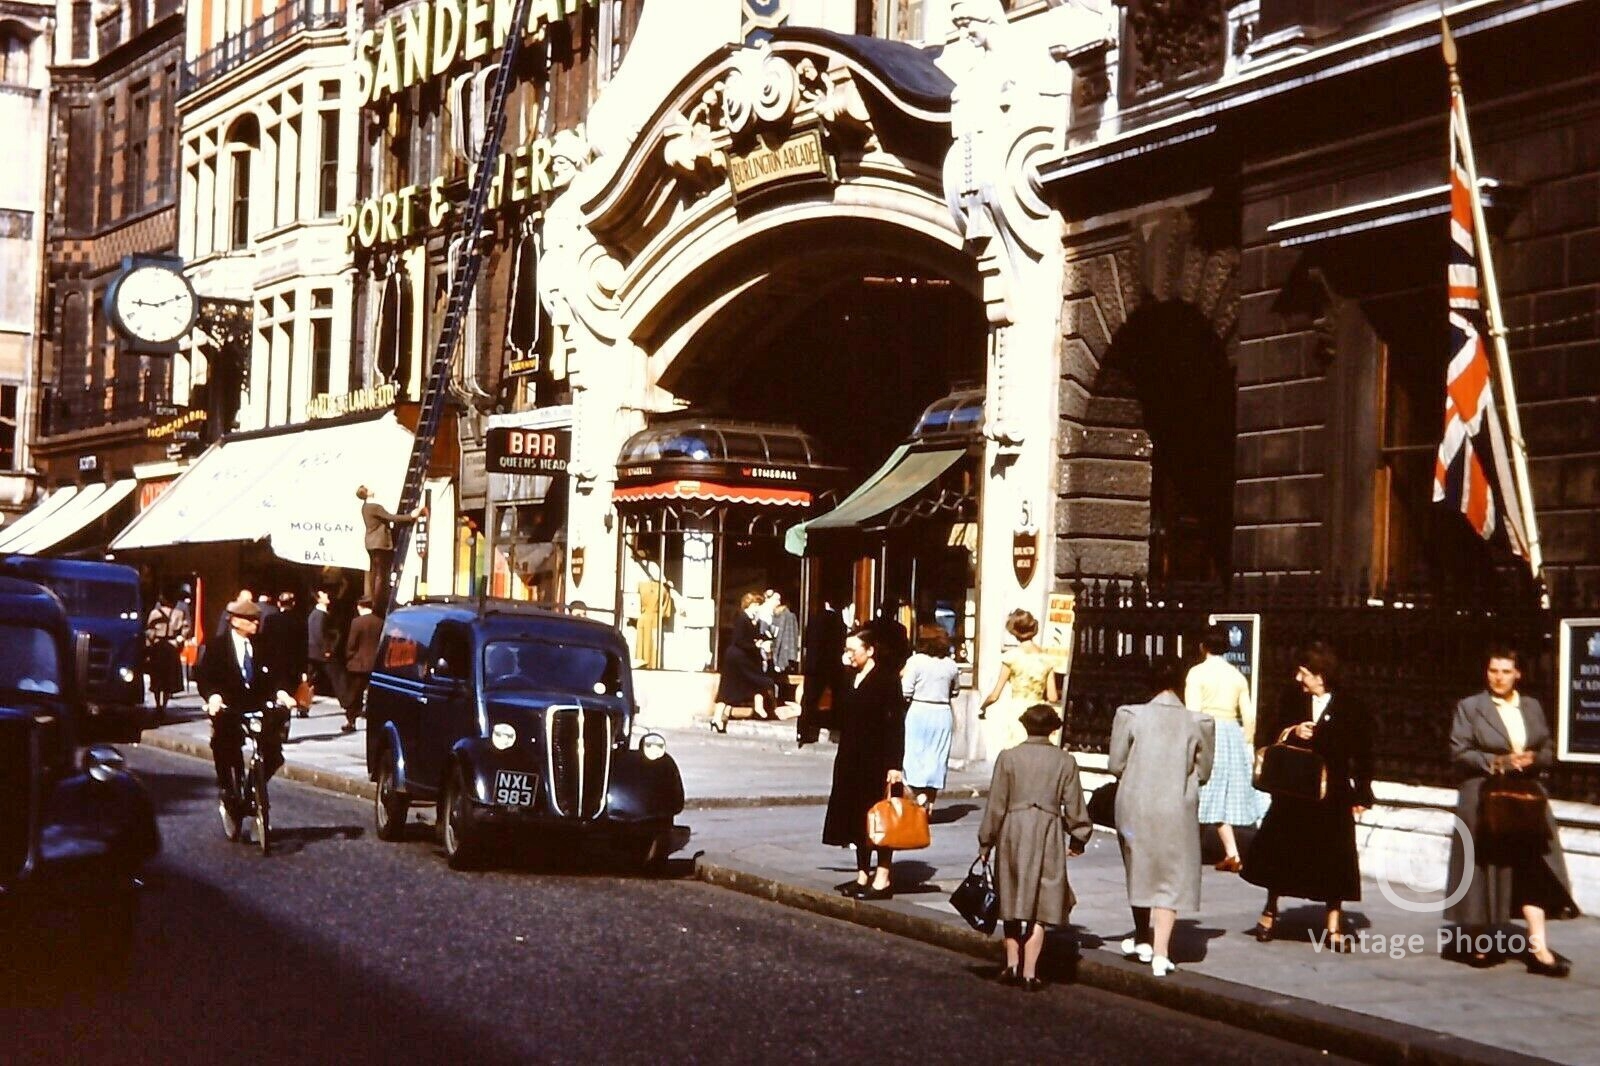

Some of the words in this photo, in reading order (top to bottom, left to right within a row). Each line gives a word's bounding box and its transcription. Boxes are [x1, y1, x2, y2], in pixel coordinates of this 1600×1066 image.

[732, 151, 782, 185] BURLINGTON
[784, 141, 819, 168] ARCADE
[343, 184, 417, 249] PORT
[508, 431, 556, 457] BAR
[499, 456, 537, 469] QUEENS
[540, 458, 567, 471] HEAD
[290, 521, 354, 533] MORGAN
[318, 536, 326, 547] &
[304, 550, 335, 562] BALL
[499, 773, 532, 790] NXL
[497, 788, 532, 806] 983
